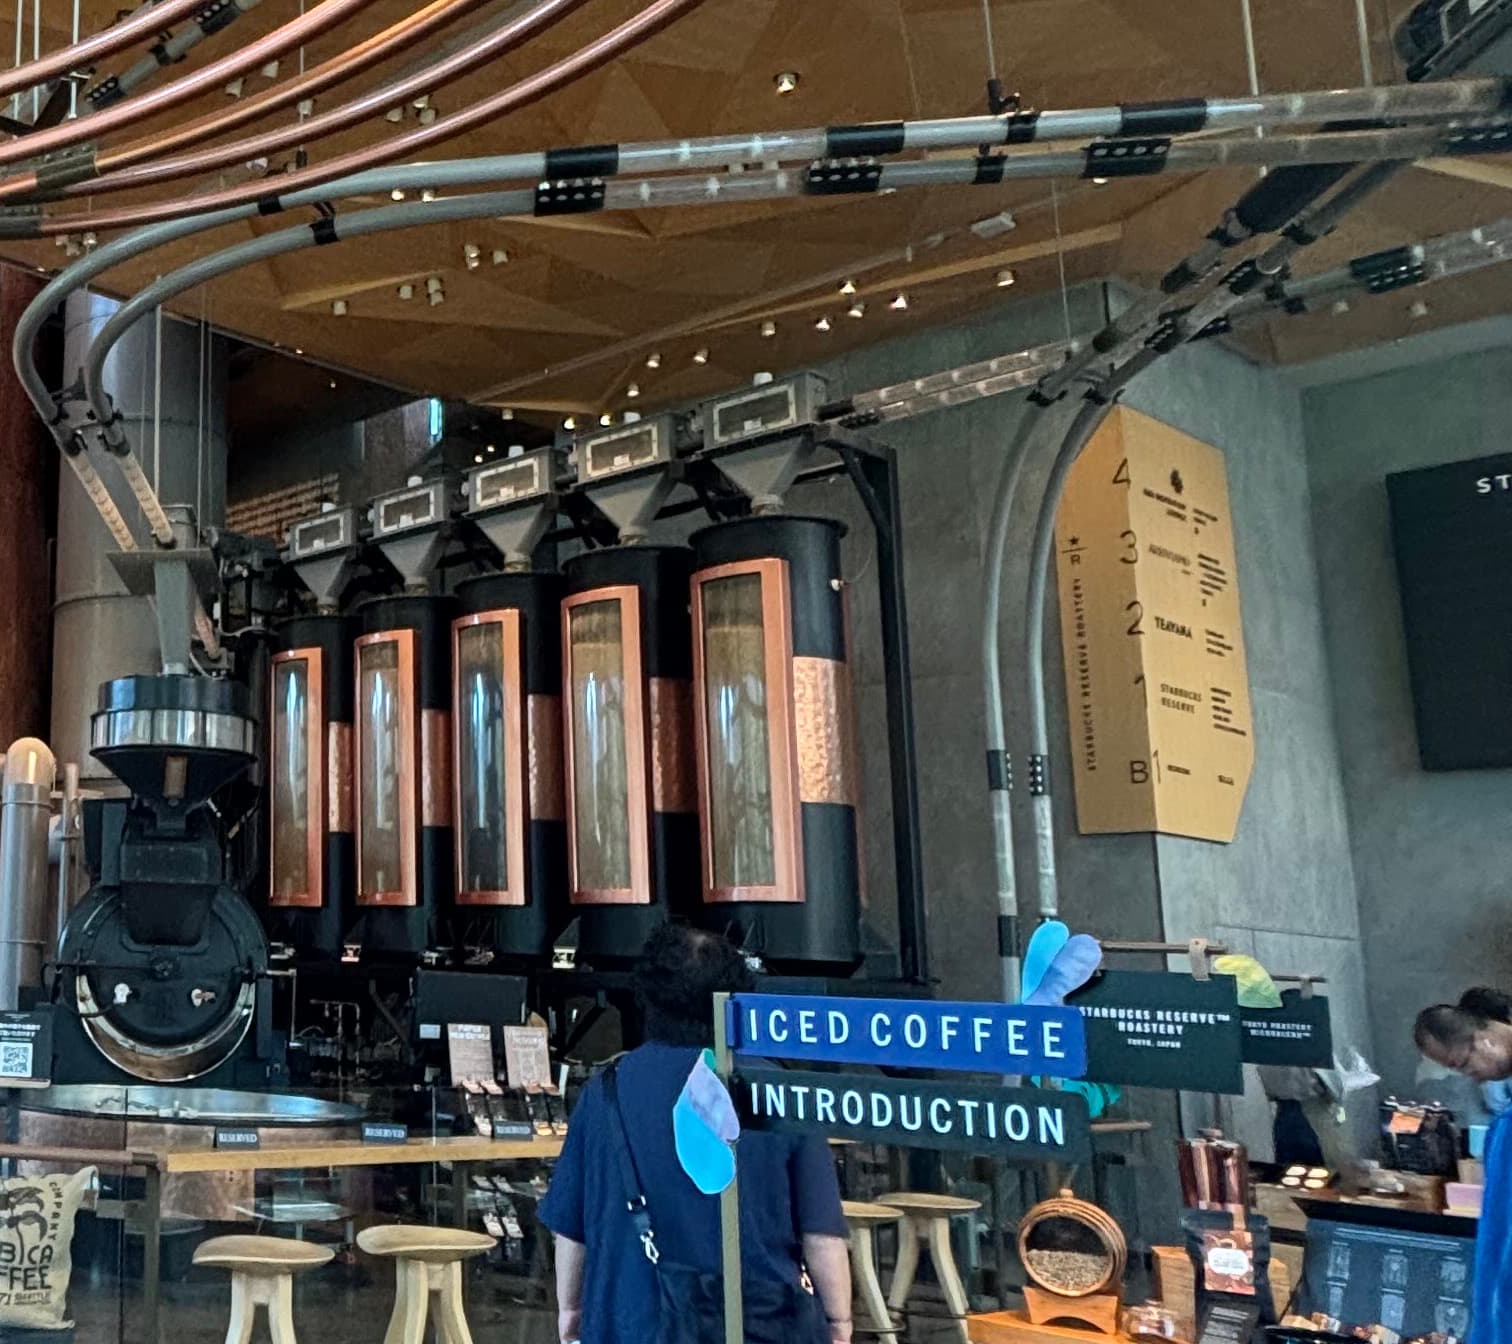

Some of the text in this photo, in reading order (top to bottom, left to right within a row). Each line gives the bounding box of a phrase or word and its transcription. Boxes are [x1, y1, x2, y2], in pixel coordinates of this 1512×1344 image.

[1112, 457, 1131, 489] 4
[1119, 529, 1138, 565] 3
[1072, 578, 1086, 638] ROASTERY
[1126, 600, 1145, 636] 2
[1077, 643, 1090, 697] RESERVE
[1160, 683, 1202, 703] STARBUCKS
[1161, 697, 1195, 714] RESERVE
[1079, 1006, 1151, 1021] STARBUCKS
[1118, 1021, 1184, 1036] ROASTERY
[749, 1008, 1066, 1059] ICED COFFEE
[750, 1082, 1066, 1146] INTRODUCTION
[218, 1132, 258, 1144] RESERVED
[364, 1127, 406, 1139] RESERVED
[49, 1181, 64, 1242] COMPANY
